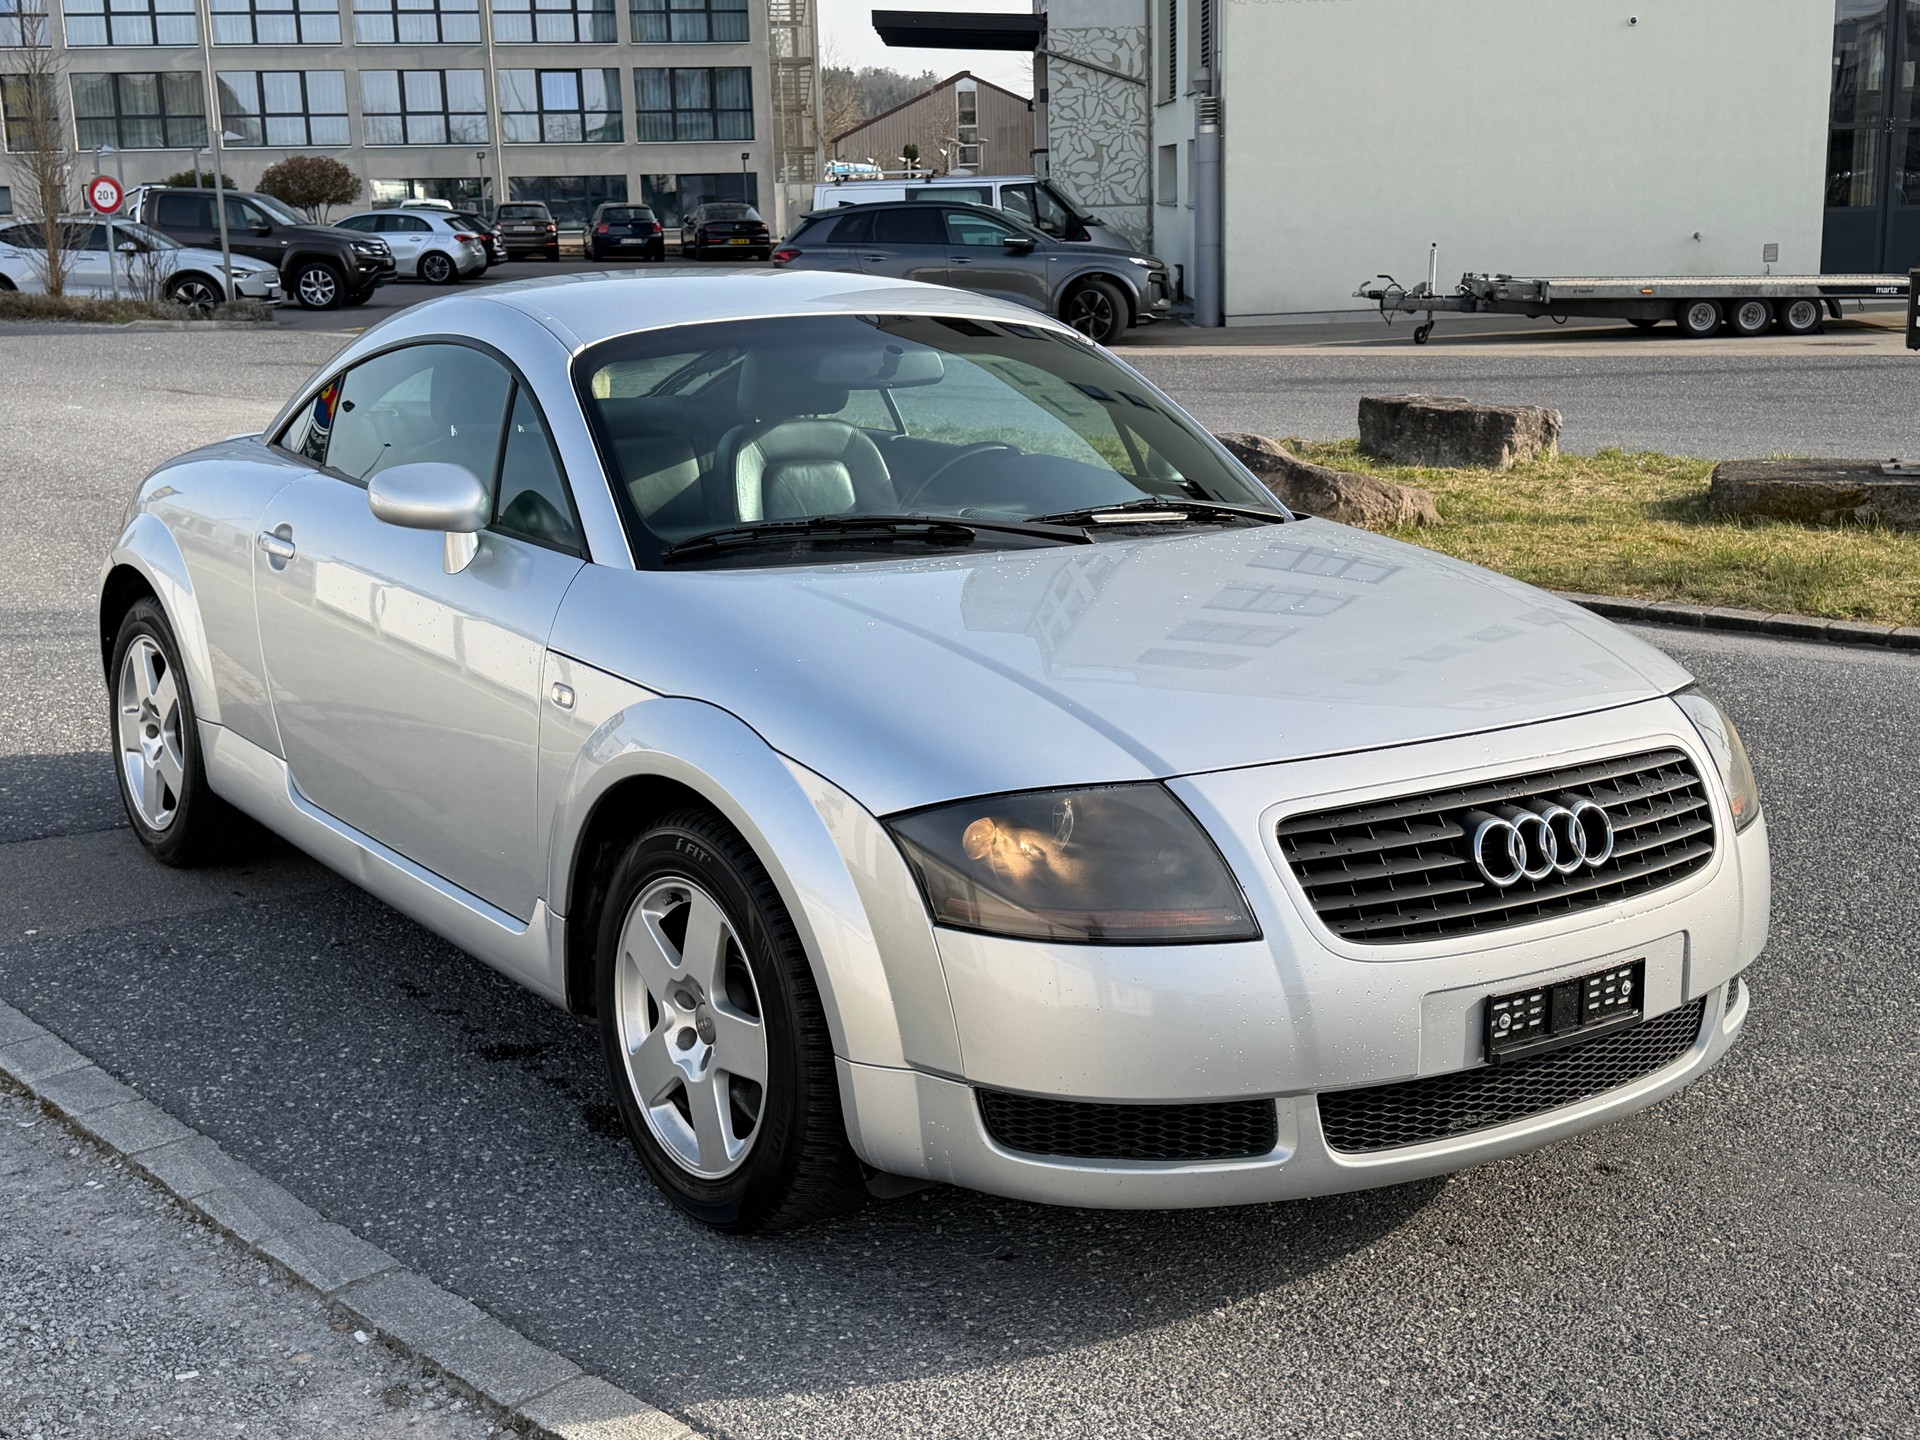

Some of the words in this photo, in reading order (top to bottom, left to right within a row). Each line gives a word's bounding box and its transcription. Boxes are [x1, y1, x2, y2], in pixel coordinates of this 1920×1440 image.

[97, 190, 109, 200] 20
[110, 190, 115, 200] t
[1875, 286, 1898, 294] martz
